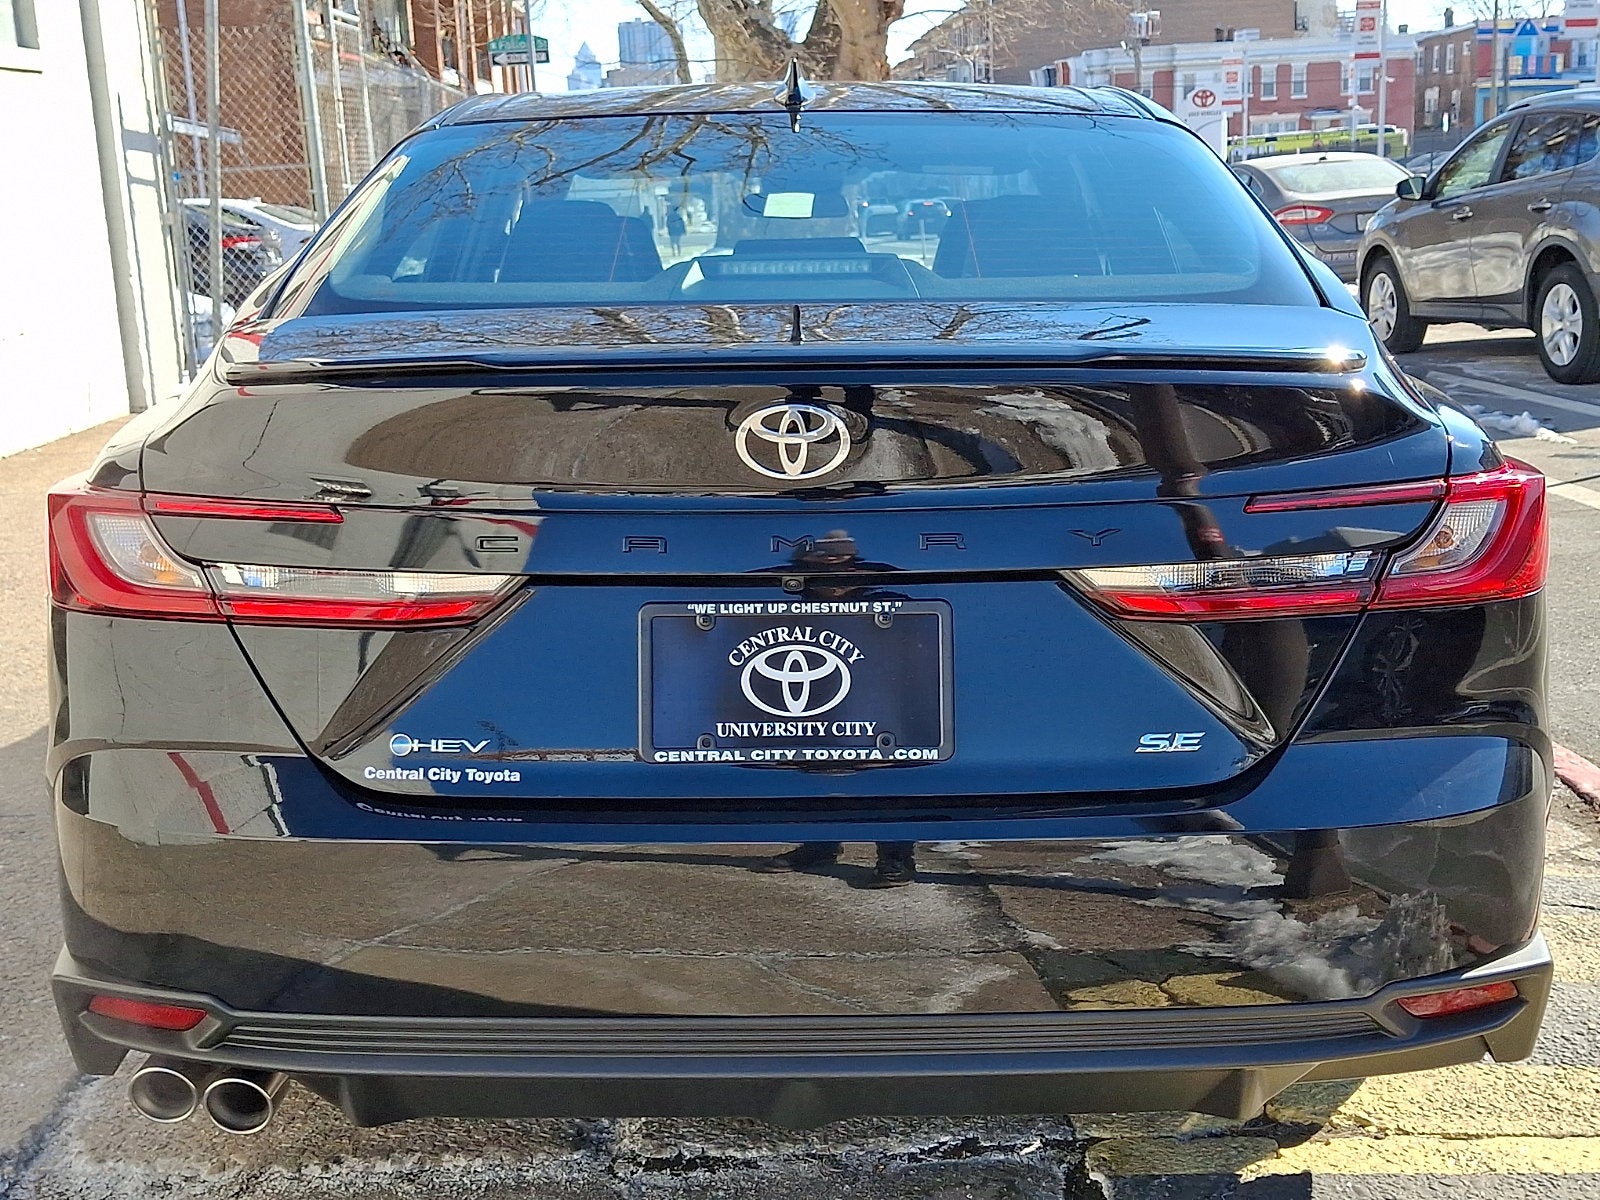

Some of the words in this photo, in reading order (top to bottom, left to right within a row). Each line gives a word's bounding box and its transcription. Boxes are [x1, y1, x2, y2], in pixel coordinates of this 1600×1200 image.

[720, 603, 763, 614] LIGHT
[767, 602, 788, 614] UP
[791, 602, 868, 613] CHESTNUT
[728, 626, 817, 667] CENTRAL
[819, 630, 865, 665] CITY
[716, 722, 828, 738] UNIVERSITY
[831, 722, 878, 737] CITY
[1135, 732, 1206, 753] SE
[654, 750, 746, 762] CENTRAL
[750, 749, 797, 761] CITY
[802, 749, 882, 760] TOYOTA
[364, 766, 424, 780] Central
[428, 767, 461, 783] City
[465, 768, 521, 784] Toyota
